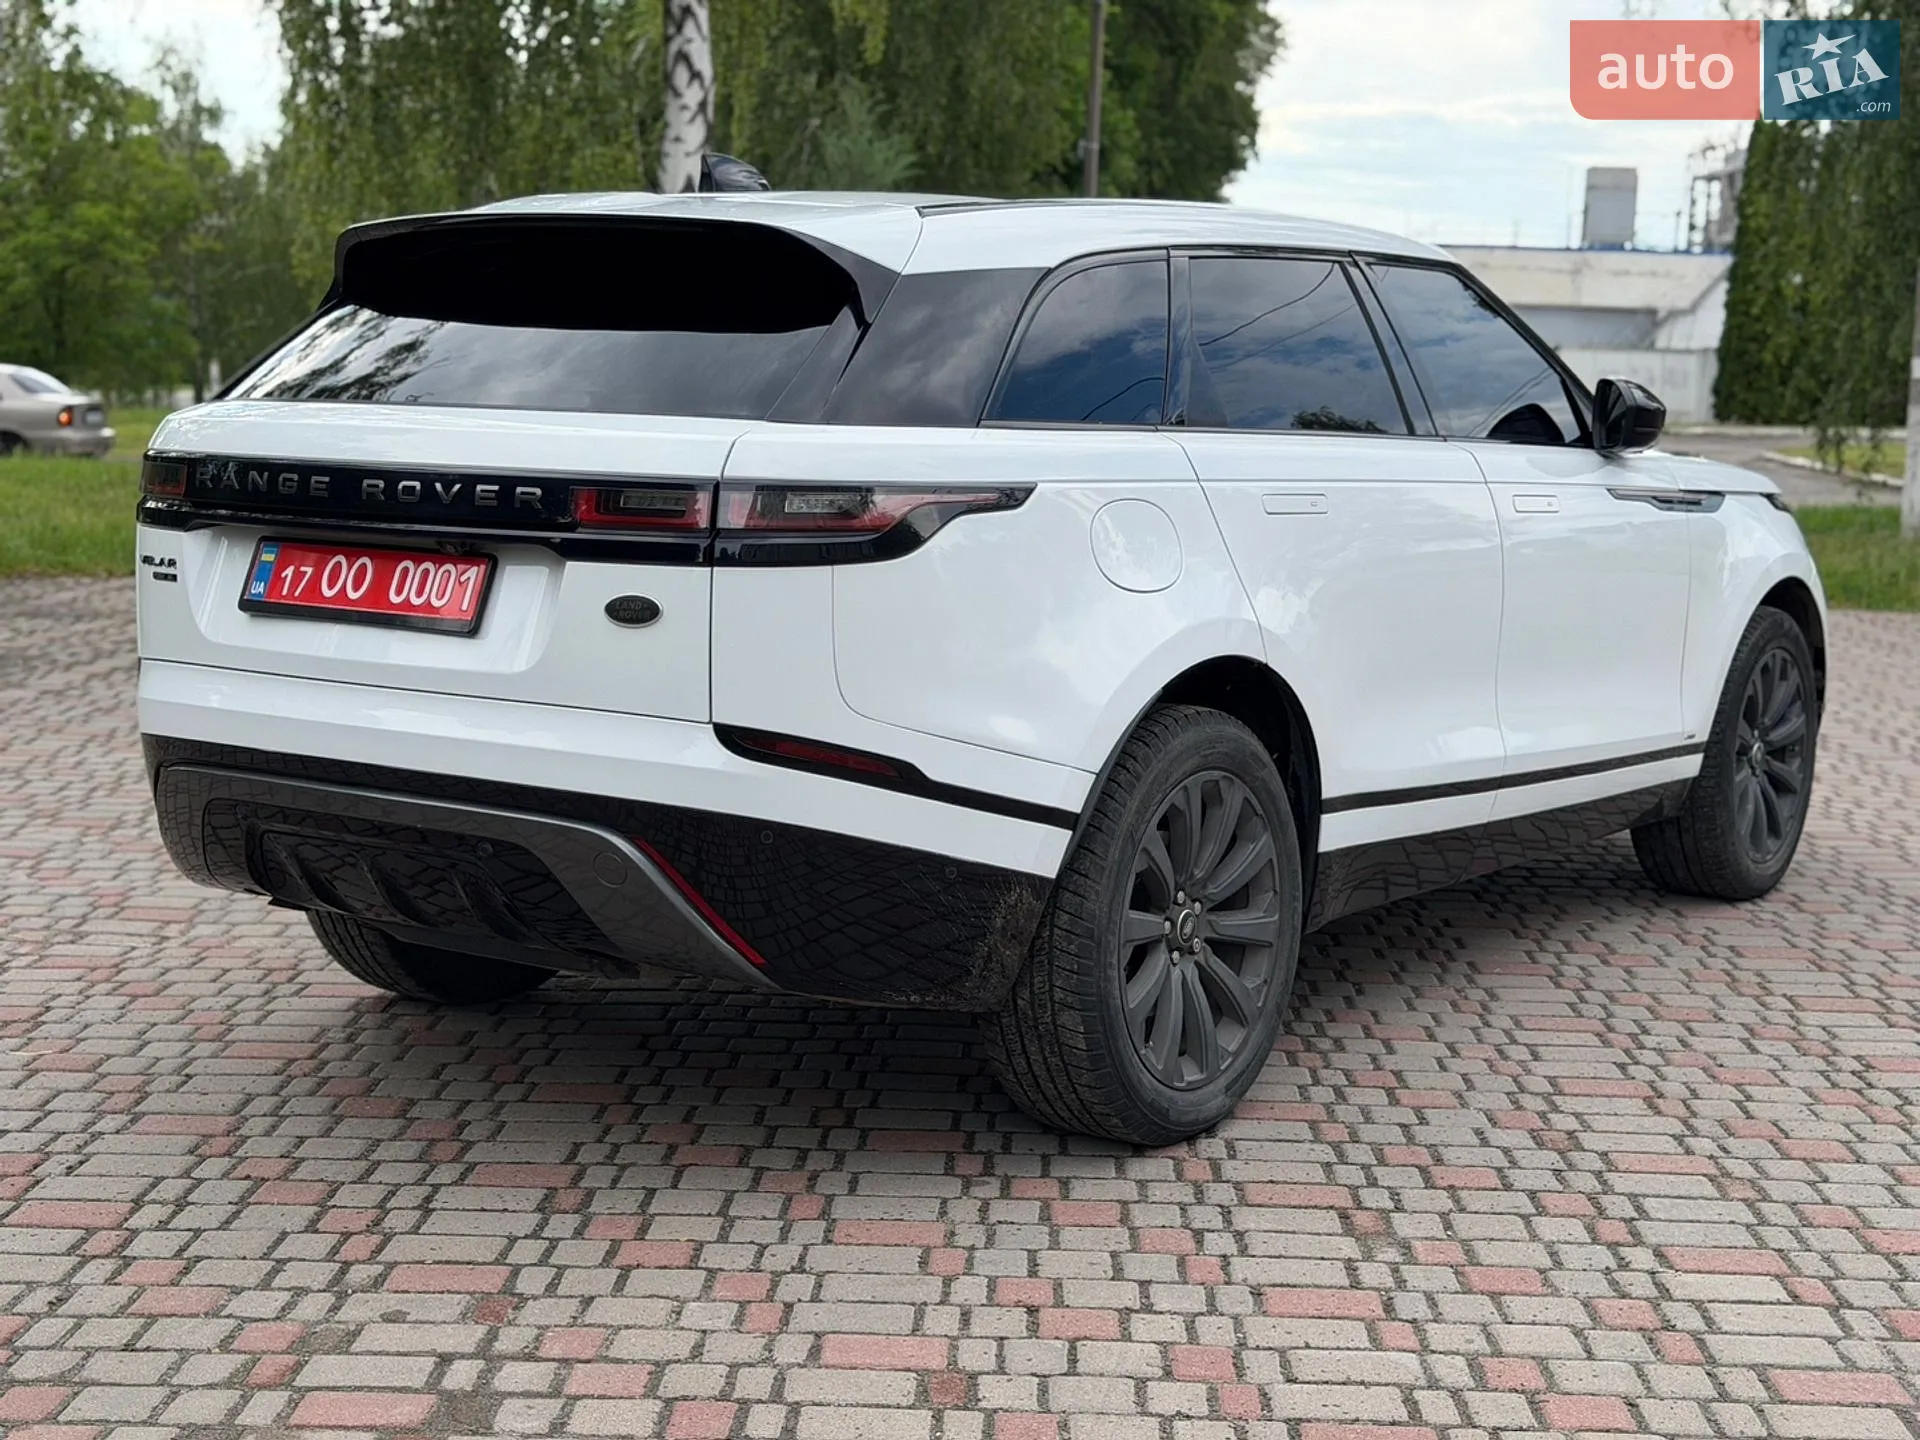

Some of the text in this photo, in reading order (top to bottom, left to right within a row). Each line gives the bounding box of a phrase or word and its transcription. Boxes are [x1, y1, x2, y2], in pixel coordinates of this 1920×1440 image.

[194, 462, 543, 510] RANGE ROVER
[251, 580, 265, 595] UA
[280, 564, 314, 598] 17
[388, 559, 480, 613] 0001
